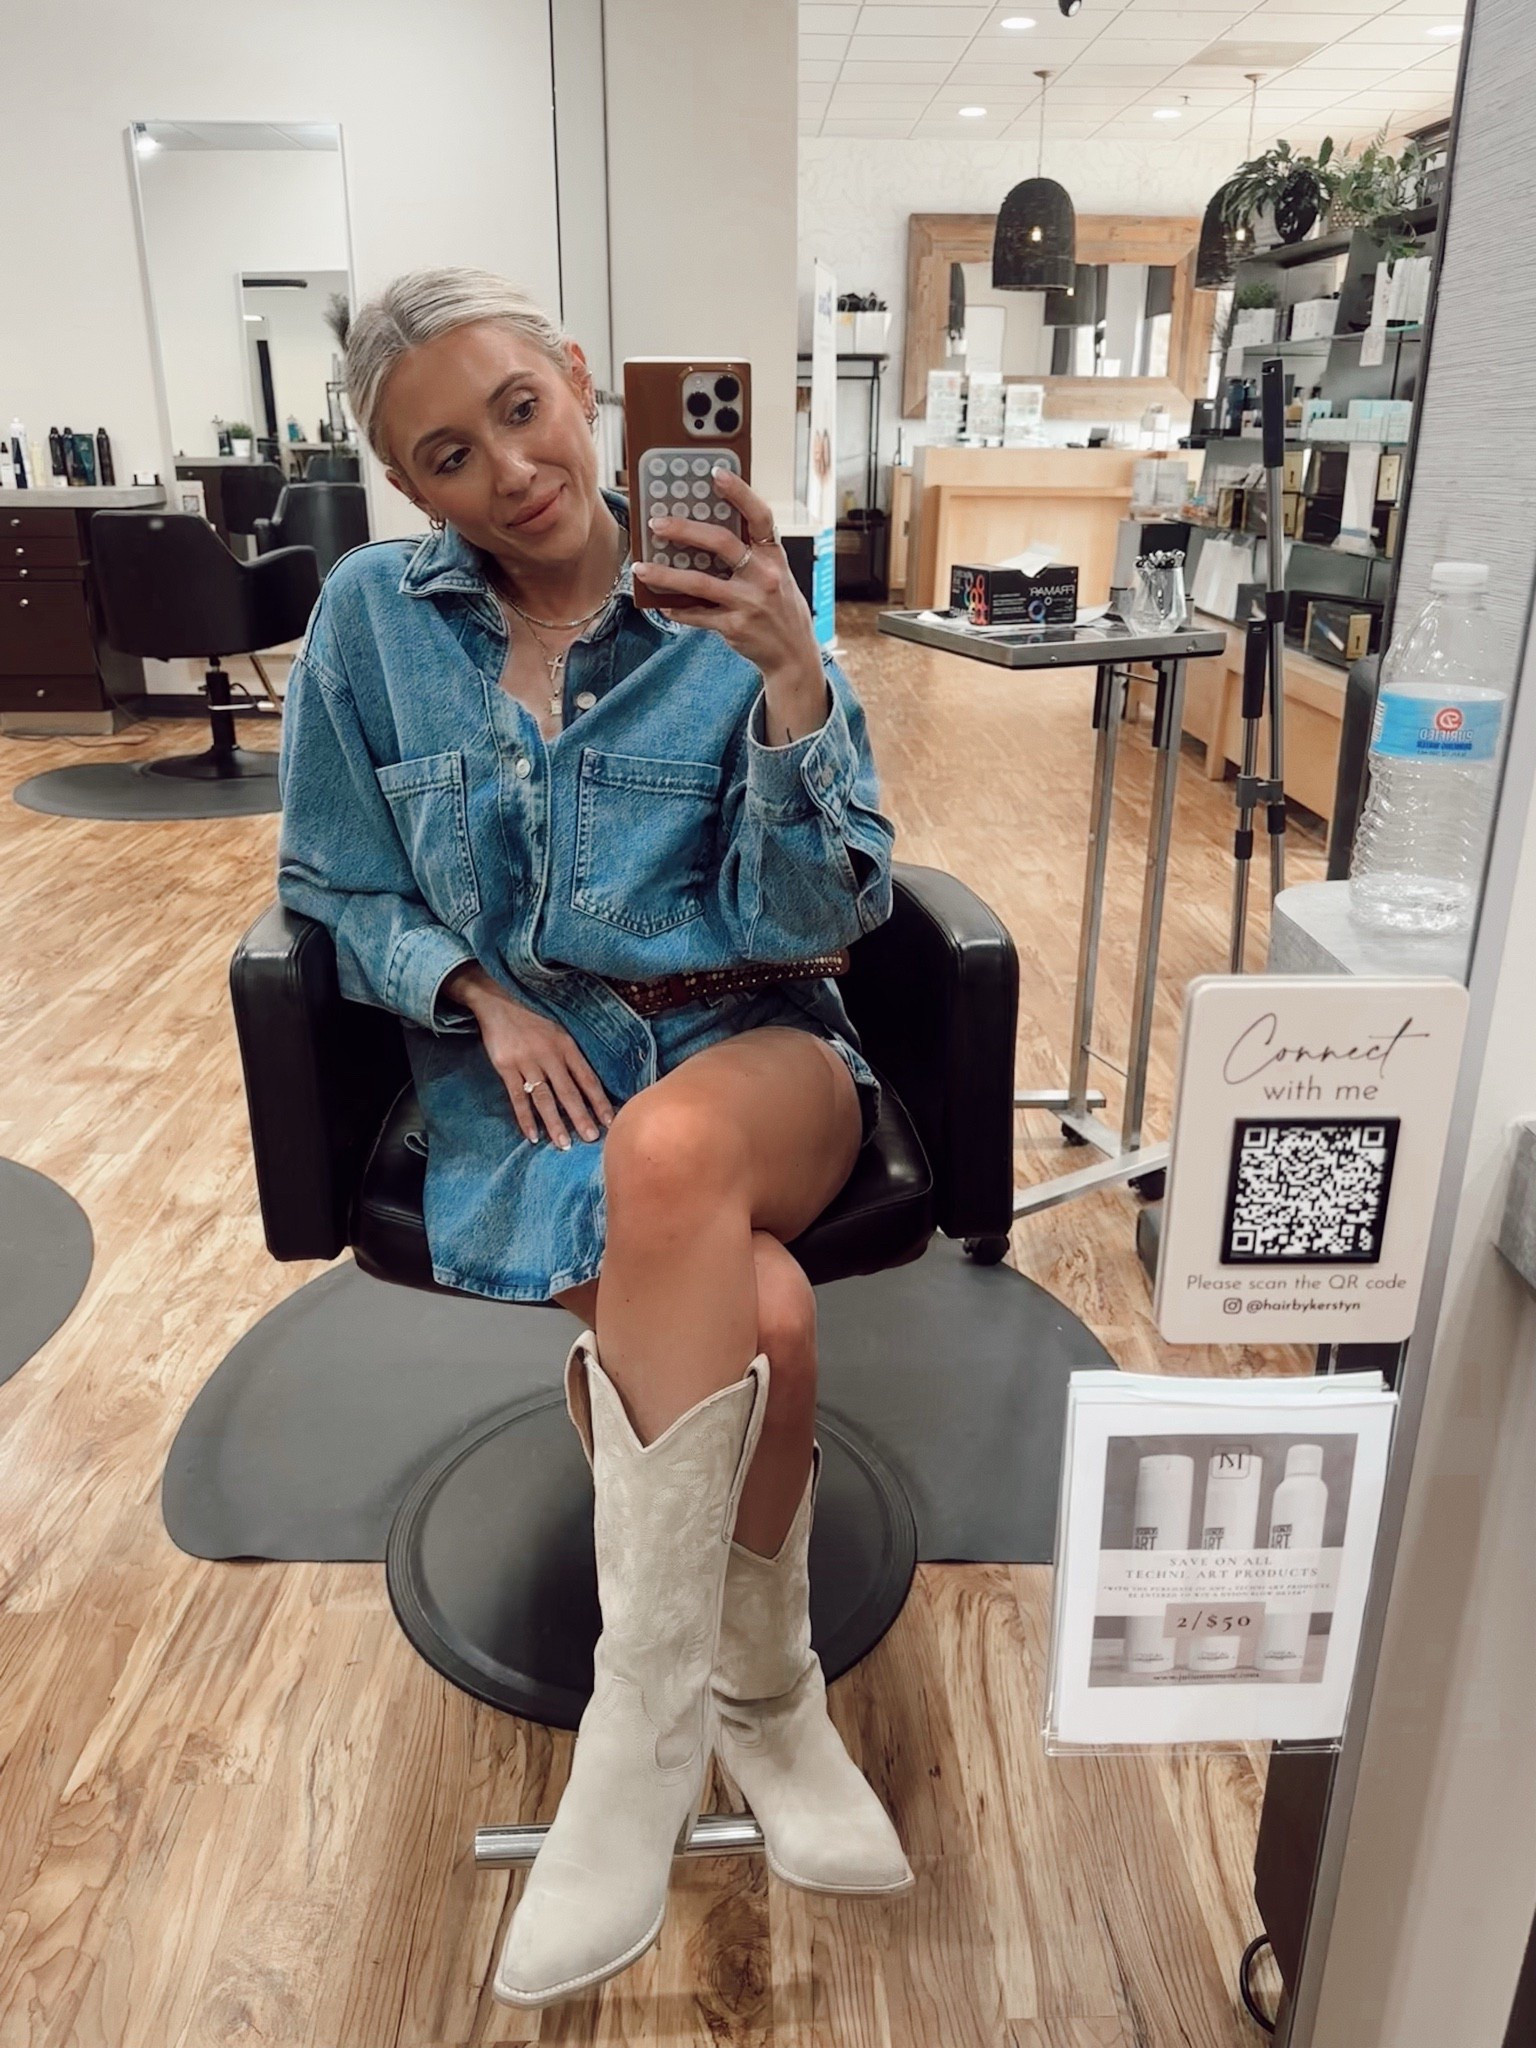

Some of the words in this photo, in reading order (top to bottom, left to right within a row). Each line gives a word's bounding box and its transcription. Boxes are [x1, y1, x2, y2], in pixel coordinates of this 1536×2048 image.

[1223, 1013, 1430, 1084] Connect
[1263, 1076, 1322, 1100] with
[1336, 1084, 1379, 1100] me
[1187, 1275, 1241, 1290] Please
[1249, 1279, 1286, 1290] scan
[1295, 1275, 1321, 1290] the
[1328, 1276, 1359, 1290] QR
[1366, 1274, 1407, 1290] code
[1246, 1298, 1361, 1314] @hairbykerstyn
[1170, 1557, 1207, 1567] SAVE
[1215, 1557, 1237, 1567] ON
[1243, 1556, 1273, 1566] ALL
[1196, 1569, 1228, 1579] ART
[1235, 1567, 1319, 1578] PRODUCTS
